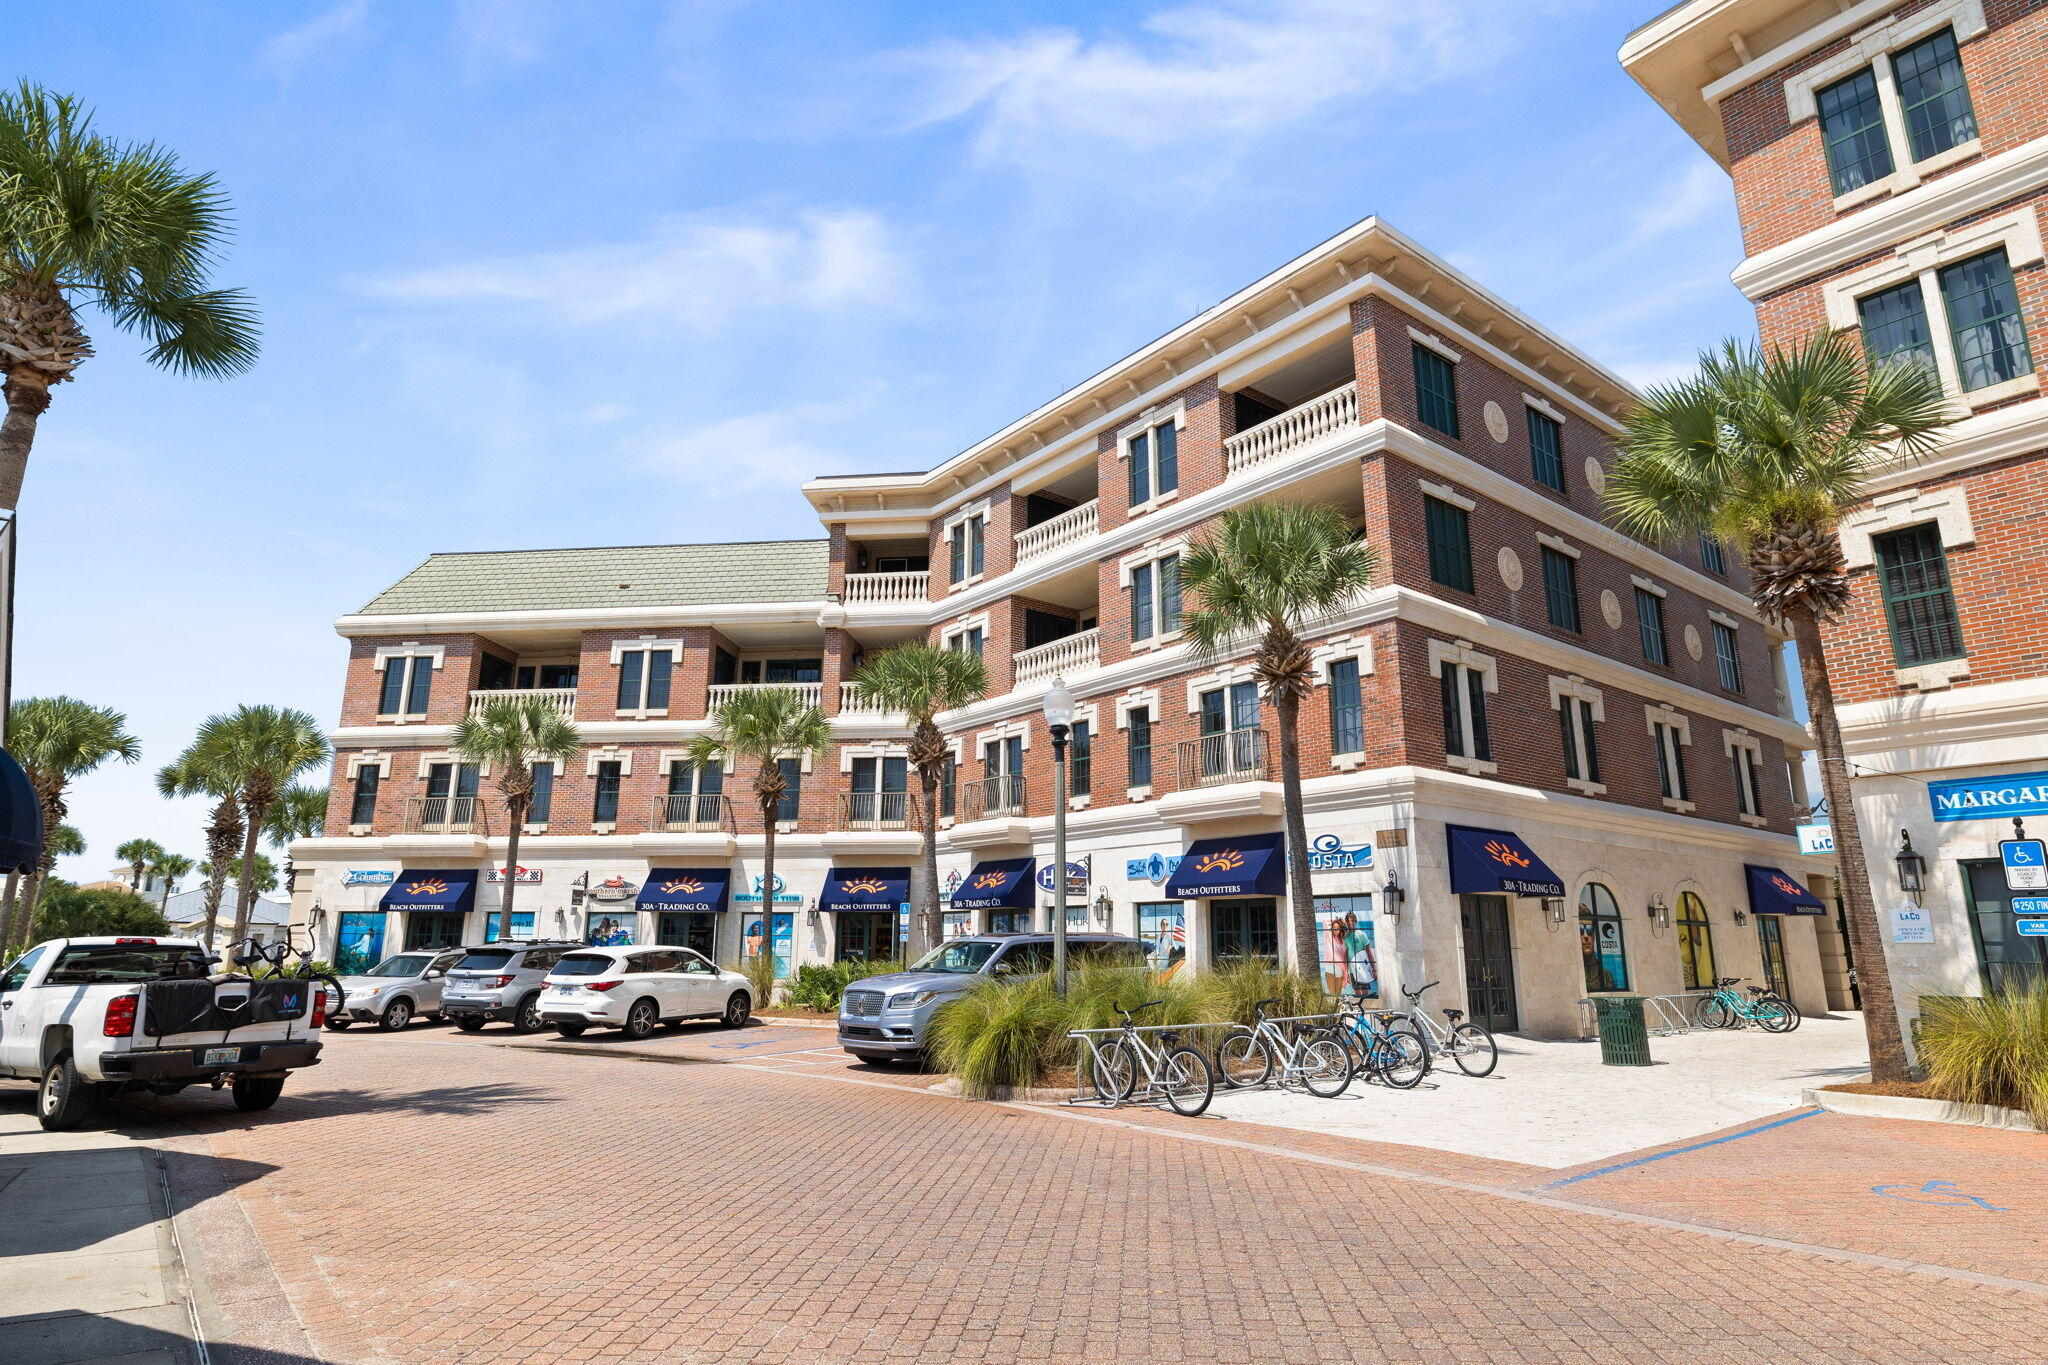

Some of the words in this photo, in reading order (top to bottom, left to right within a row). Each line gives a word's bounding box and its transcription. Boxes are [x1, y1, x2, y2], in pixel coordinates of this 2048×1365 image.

[1311, 853, 1356, 869] OSTA
[353, 871, 390, 882] Columbia
[1177, 887, 1199, 896] BEACH
[1199, 885, 1241, 895] OUTFITTERS
[696, 902, 710, 911] CO.
[2014, 901, 2035, 911] $250
[1601, 940, 1619, 950] COSTA
